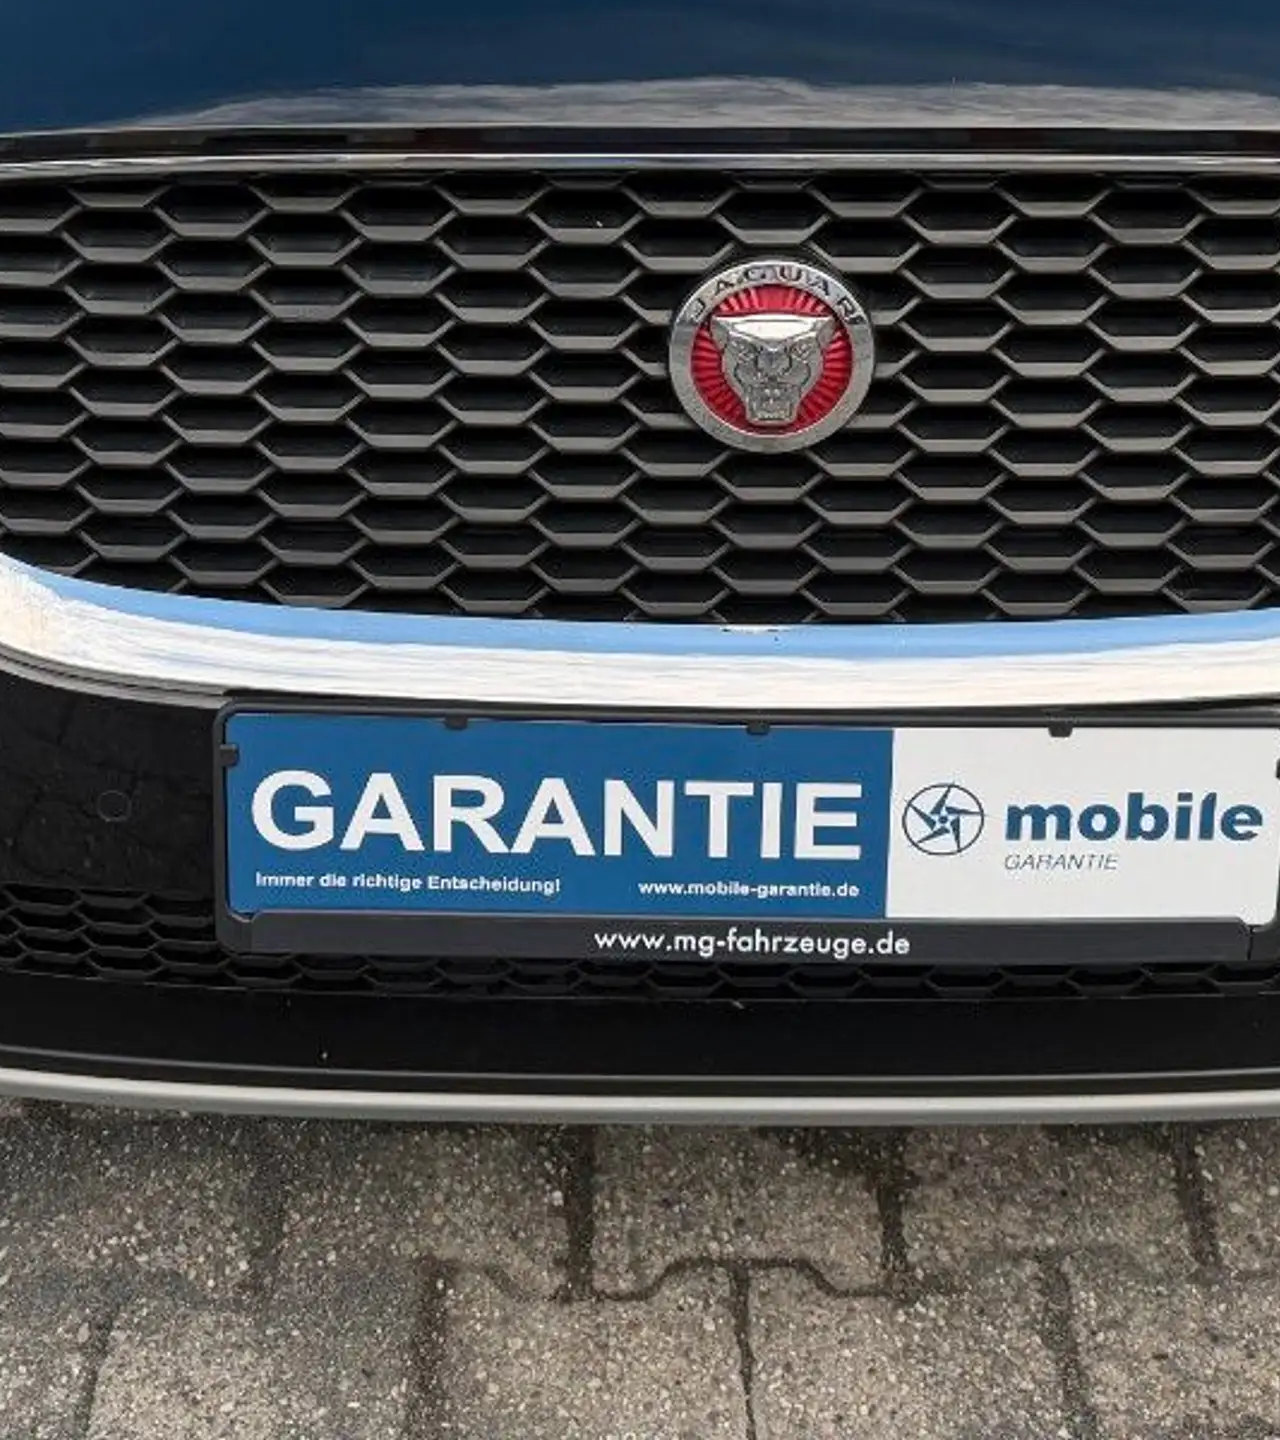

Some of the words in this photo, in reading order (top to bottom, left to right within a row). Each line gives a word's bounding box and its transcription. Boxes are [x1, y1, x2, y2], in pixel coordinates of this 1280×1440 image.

[688, 264, 867, 326] JAGUAR
[251, 770, 862, 861] GARANTIE
[1005, 792, 1263, 841] mobile
[1004, 854, 1118, 871] GARANTIE
[255, 872, 313, 888] Immer
[319, 873, 347, 888] die
[353, 874, 422, 892] richtige
[427, 875, 561, 895] Entscheidung!
[637, 880, 860, 899] www.mobile-garantie.de
[594, 927, 911, 959] www.mg-fahrzeuge.de
